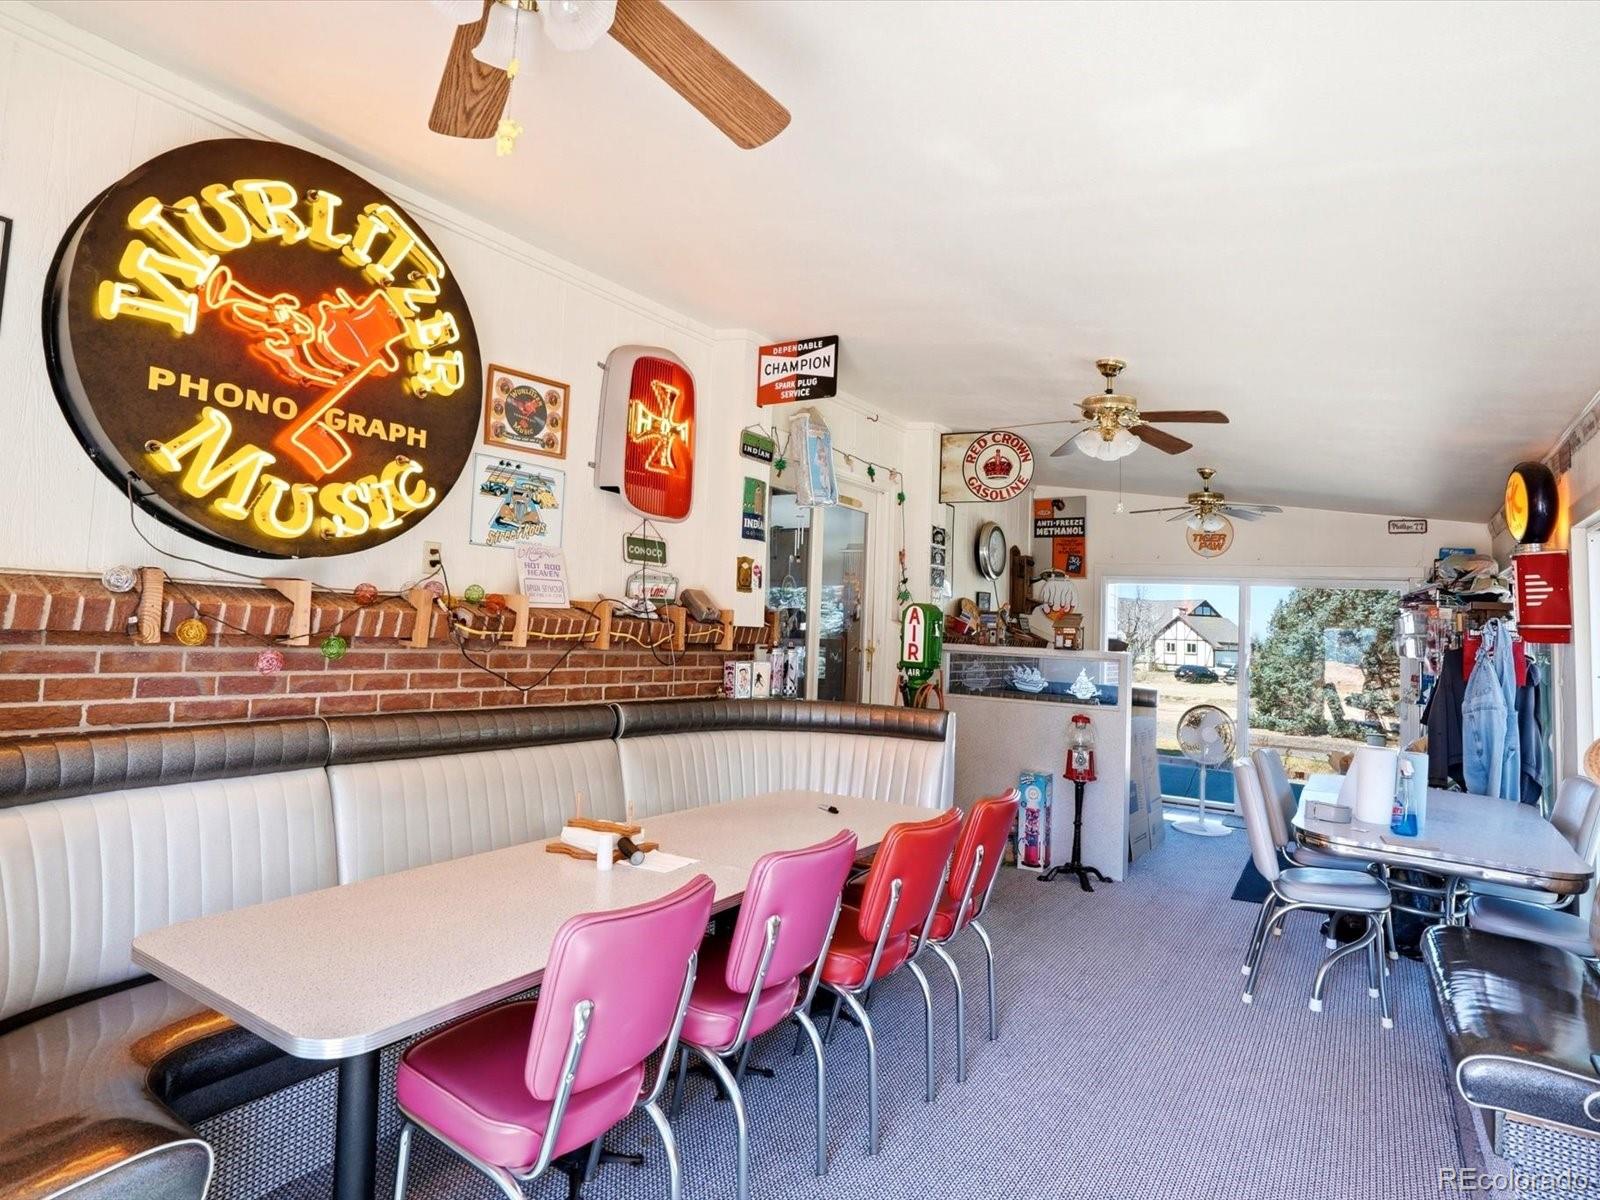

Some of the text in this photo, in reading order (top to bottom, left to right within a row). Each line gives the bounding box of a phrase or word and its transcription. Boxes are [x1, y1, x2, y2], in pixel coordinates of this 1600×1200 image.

[98, 178, 466, 397] WURLITZER
[772, 340, 824, 355] DEPENDABLE
[764, 355, 831, 376] CHAMPION
[774, 377, 818, 390] SPARK PLUG
[148, 366, 299, 421] PHONO
[780, 387, 811, 400] SERVICE
[323, 408, 428, 449] GRAPH
[743, 444, 771, 459] INDIAN
[965, 432, 1032, 464] RED CROWN
[967, 475, 1029, 501] GASOLINE
[1036, 526, 1084, 536] METHANOL
[1192, 533, 1227, 542] TIGER
[628, 545, 663, 557] CONOCO
[527, 569, 561, 578] HEAVEN
[907, 607, 921, 661] AIR
[907, 668, 921, 677] AIR
